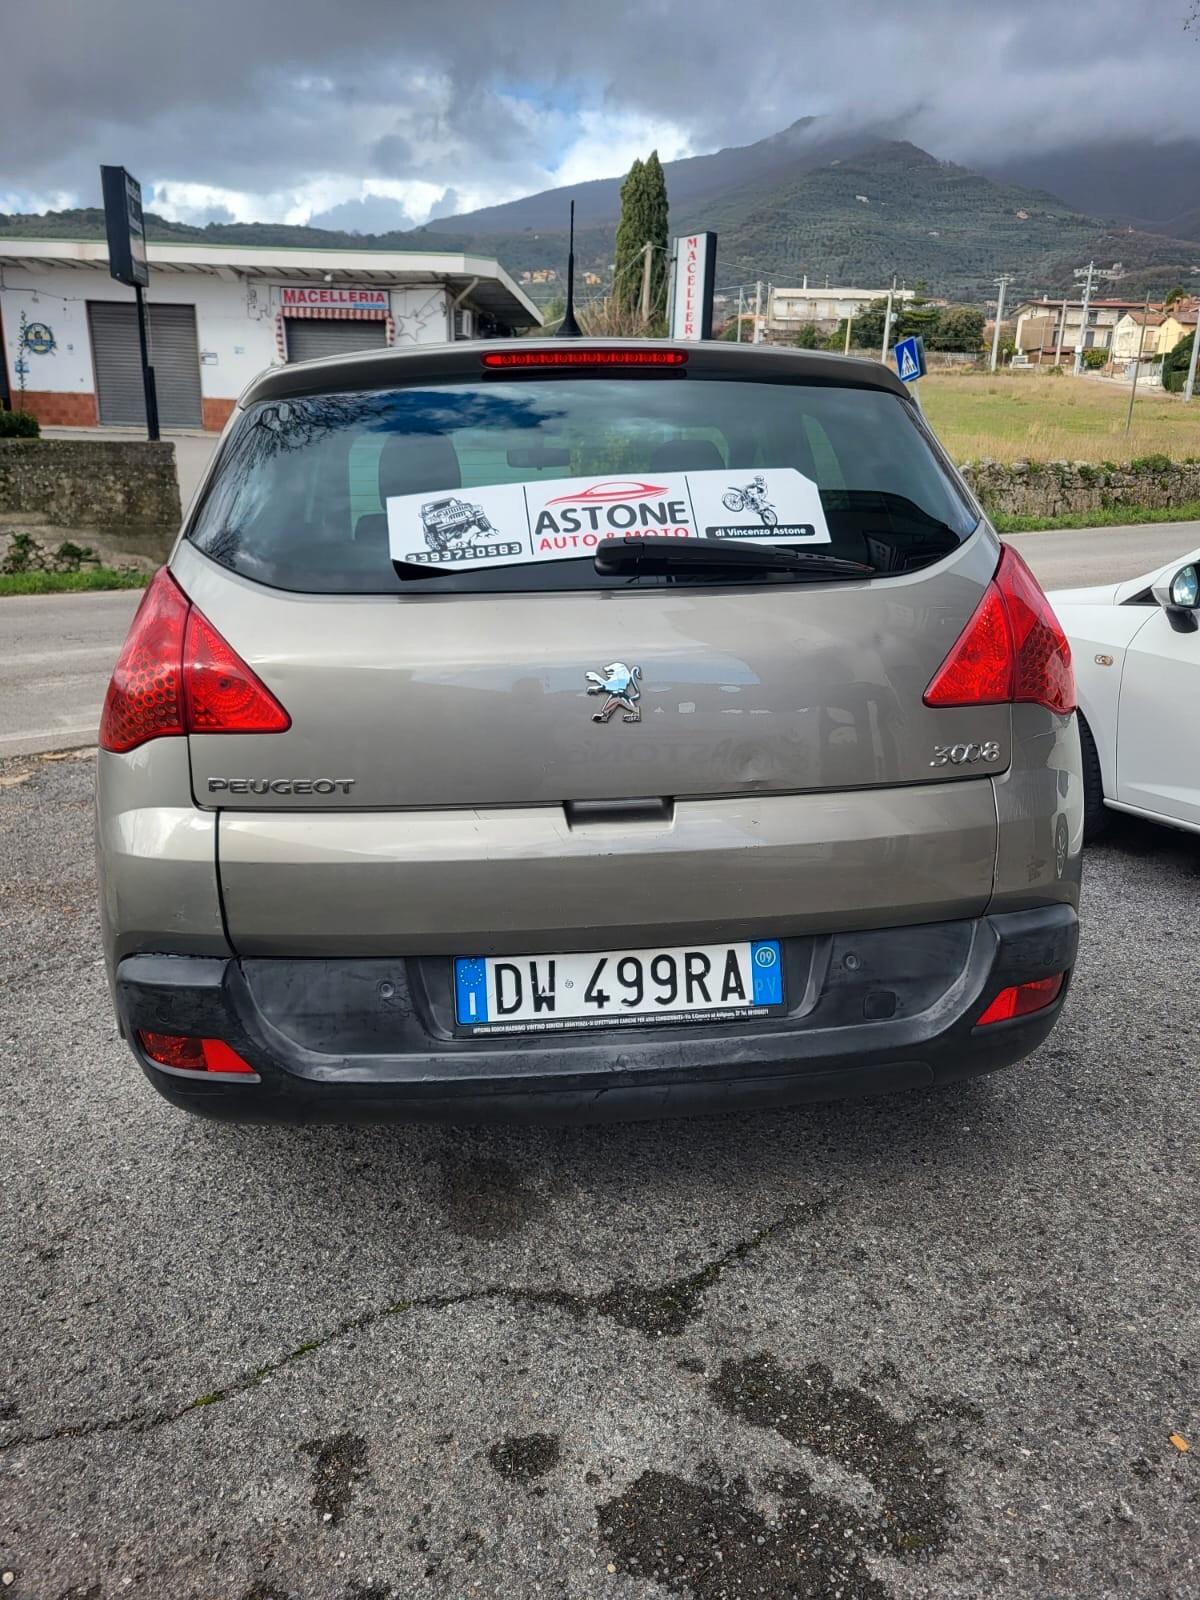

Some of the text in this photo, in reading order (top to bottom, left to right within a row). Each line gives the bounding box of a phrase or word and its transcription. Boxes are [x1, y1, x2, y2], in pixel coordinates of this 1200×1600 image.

[283, 288, 385, 304] MACELLERIA
[684, 237, 698, 340] MACELLER
[535, 501, 690, 535] ASTONE
[540, 534, 598, 550] AUTO
[715, 526, 806, 537] di Vincenzo Astone
[928, 741, 1000, 767] 3008
[207, 777, 356, 794] PEUGEOT
[759, 951, 773, 963] 09
[495, 949, 746, 1015] DW 499RA
[754, 976, 776, 1001] PV
[469, 992, 476, 1016] I
